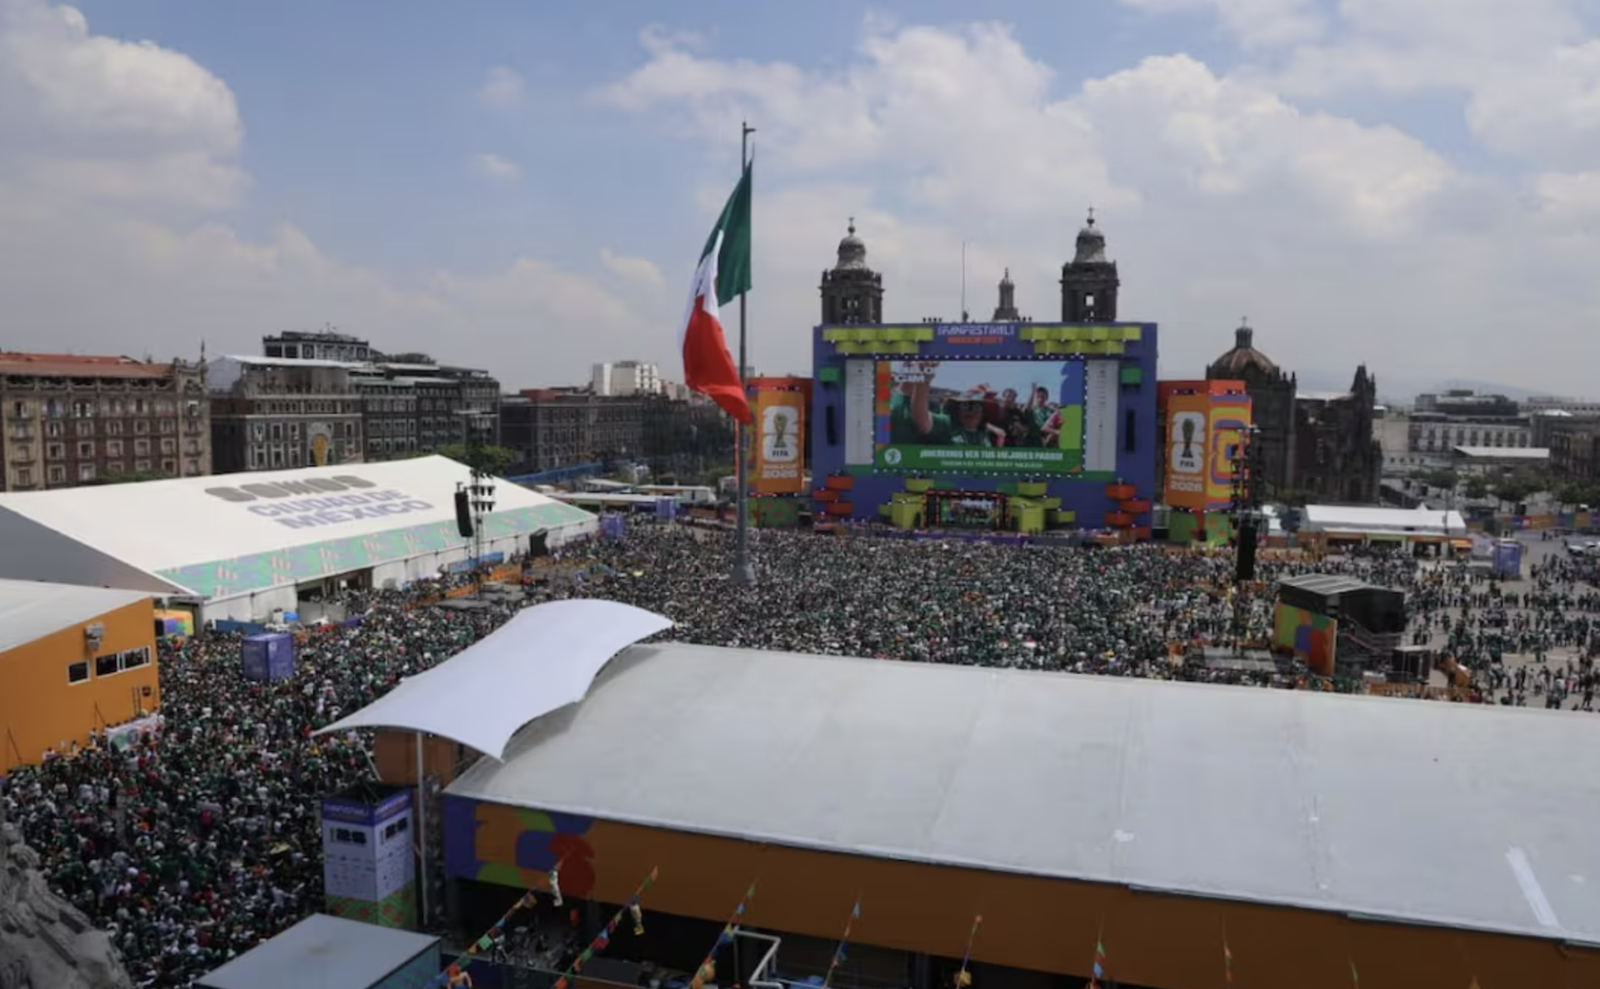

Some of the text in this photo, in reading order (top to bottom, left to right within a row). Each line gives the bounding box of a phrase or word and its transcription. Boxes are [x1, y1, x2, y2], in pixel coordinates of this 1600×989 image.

[1180, 460, 1195, 468] FIFA
[247, 488, 410, 517] CIUDAD DE
